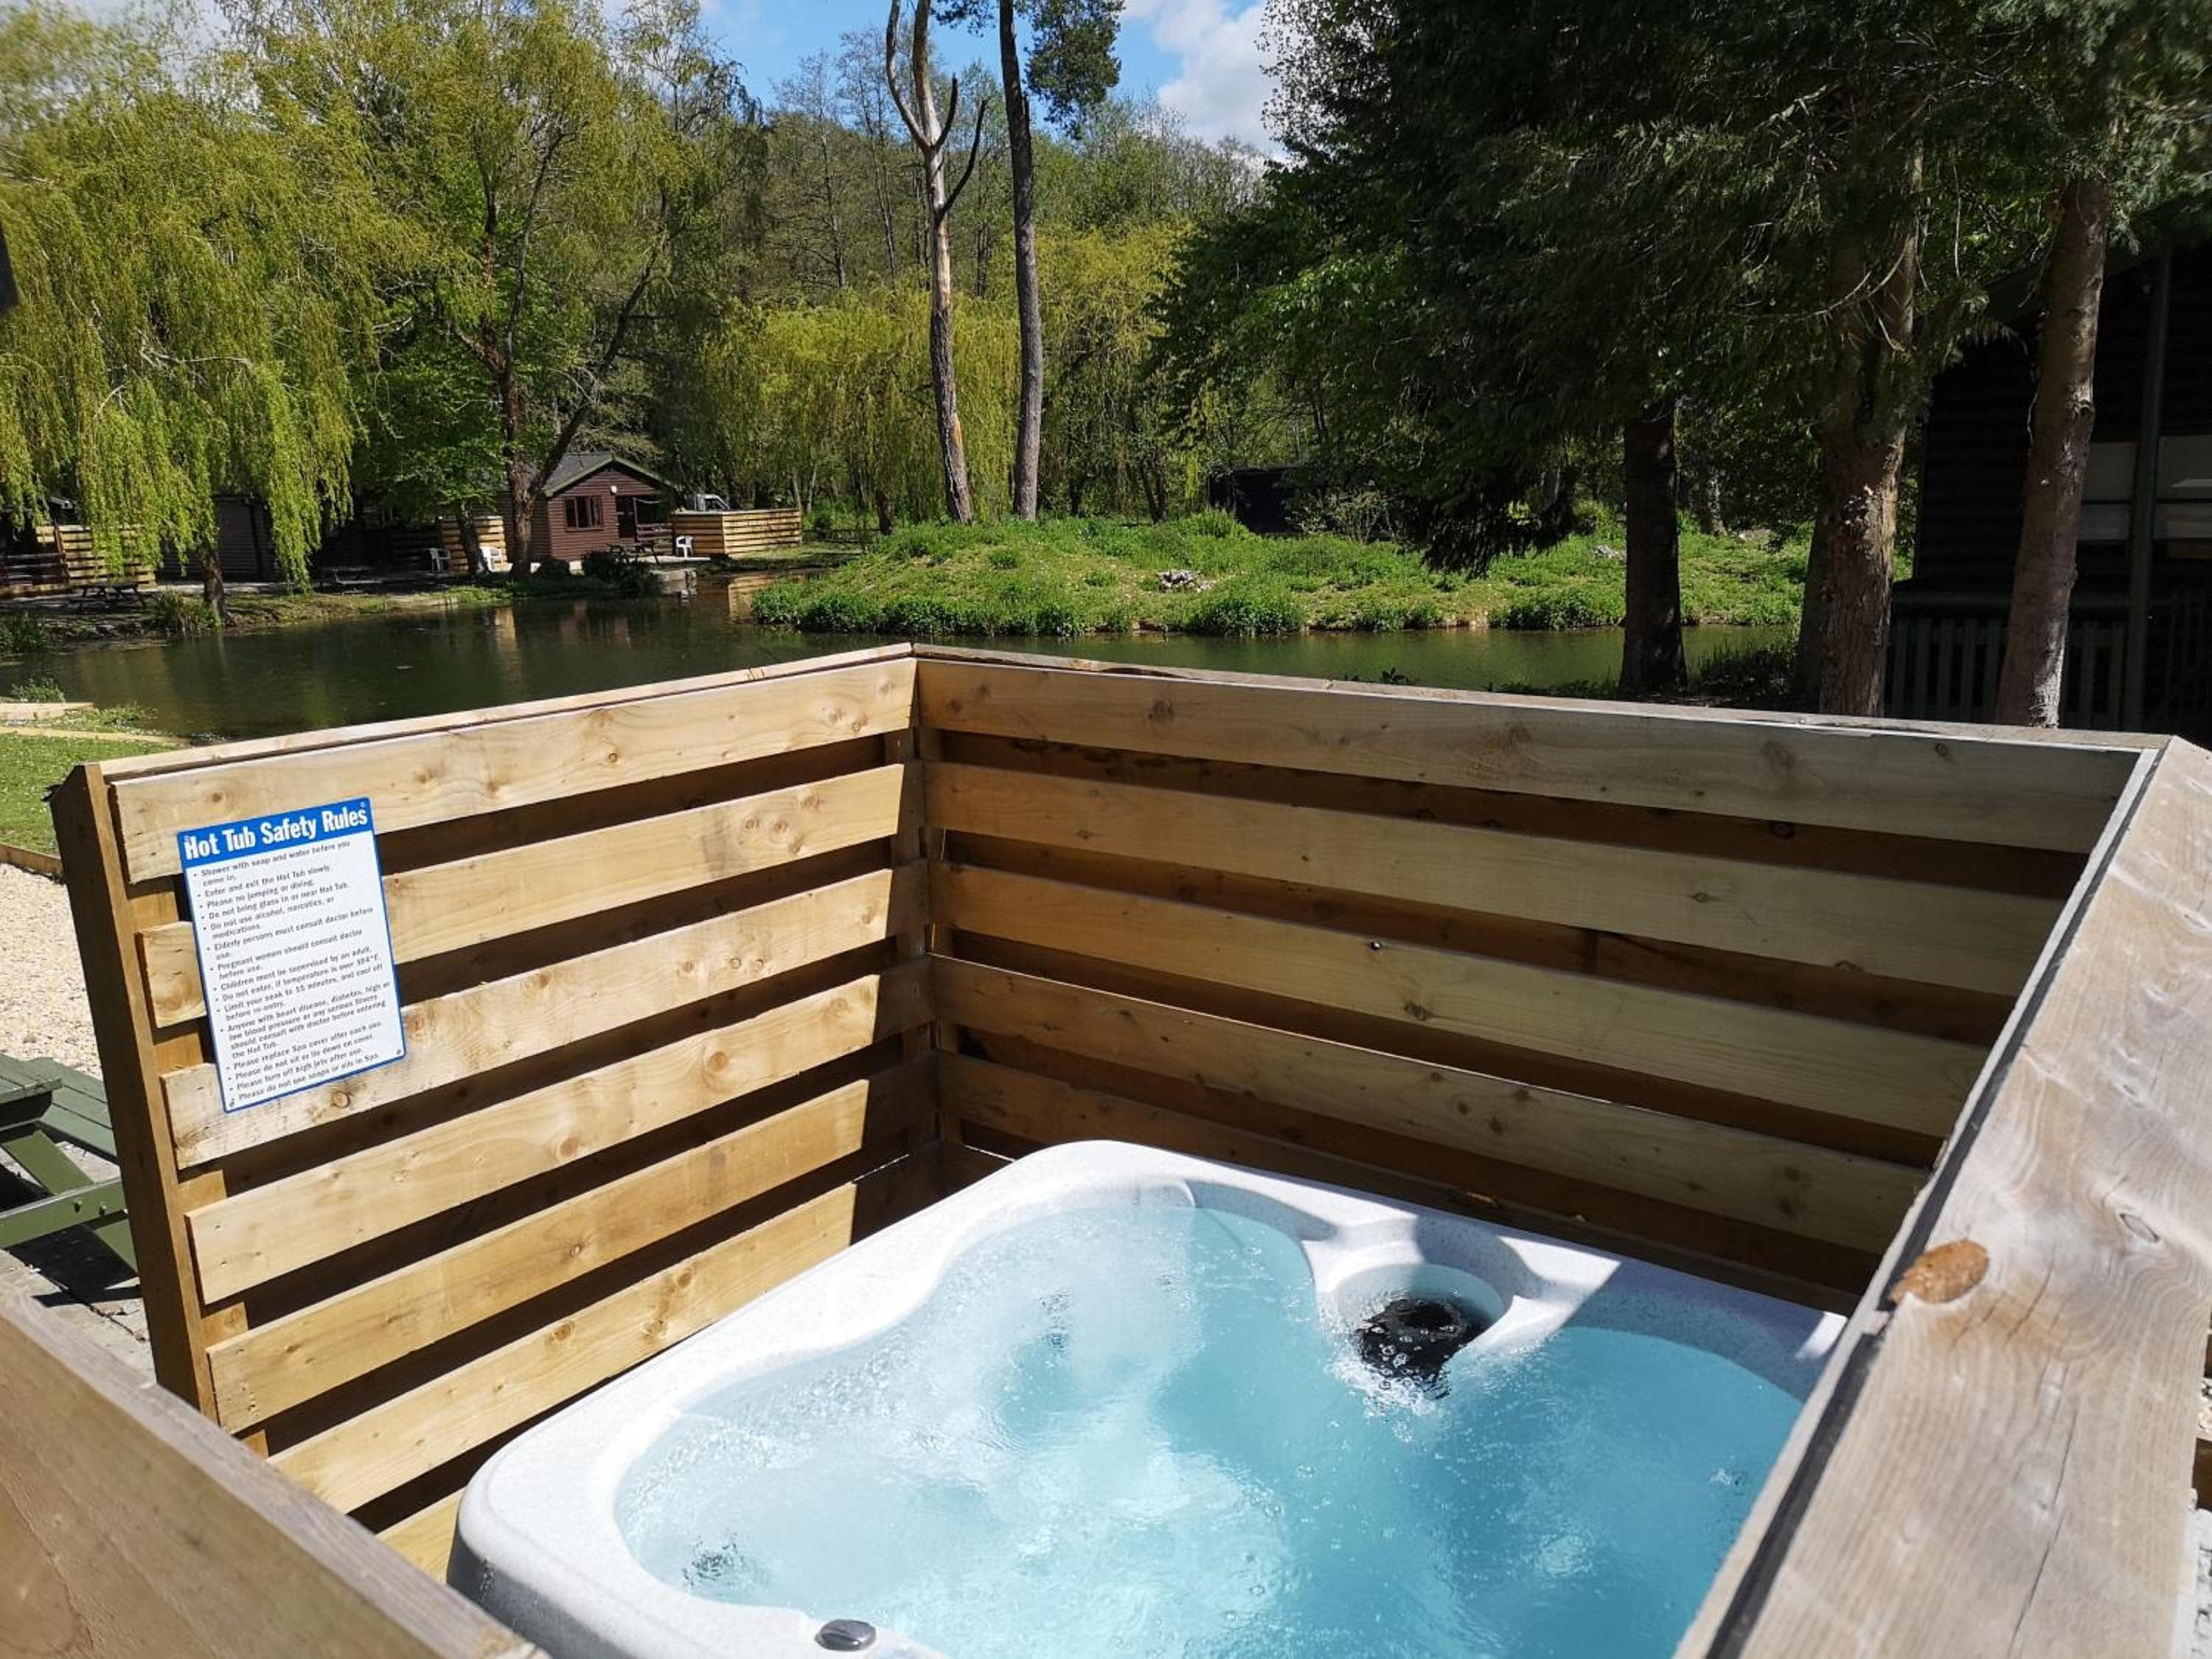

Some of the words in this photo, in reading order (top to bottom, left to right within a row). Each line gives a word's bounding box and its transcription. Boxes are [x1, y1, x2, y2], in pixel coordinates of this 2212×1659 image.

[184, 833, 220, 859] Hot
[222, 824, 256, 852] Tub
[260, 816, 318, 844] Safety
[321, 807, 367, 832] Rules
